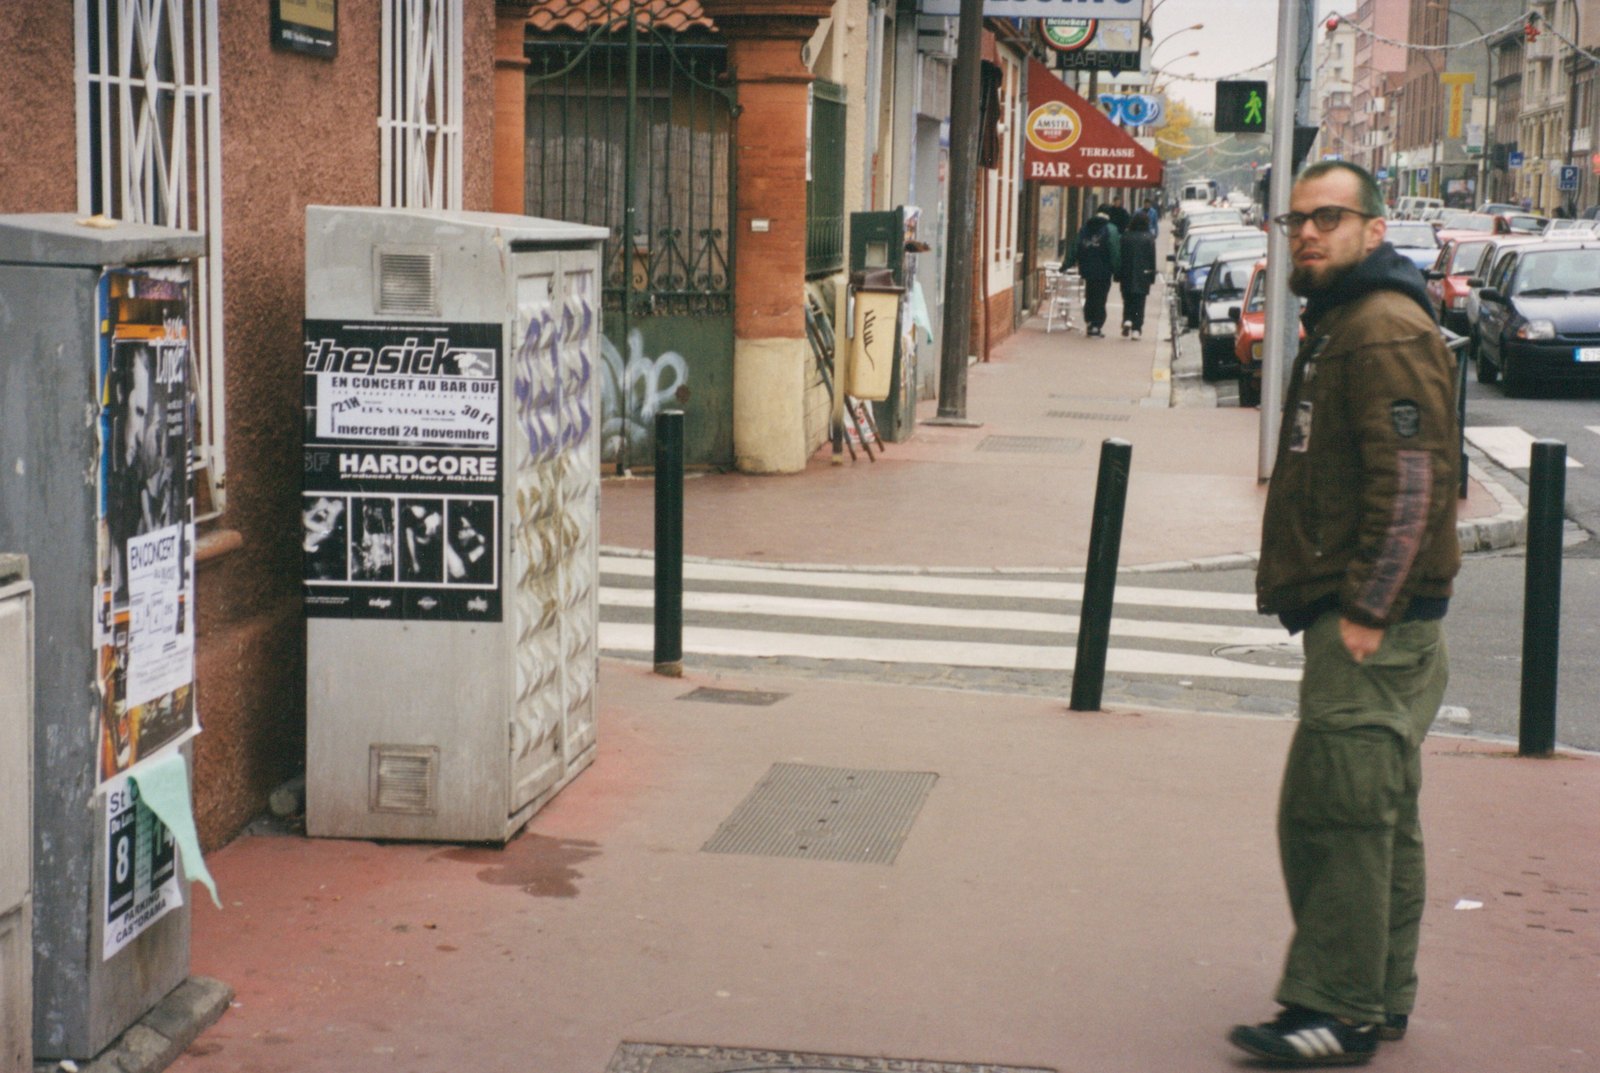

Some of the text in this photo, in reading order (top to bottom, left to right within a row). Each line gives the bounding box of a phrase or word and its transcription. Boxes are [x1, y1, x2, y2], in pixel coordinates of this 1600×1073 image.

[1037, 120, 1069, 128] AMSTEL
[1079, 147, 1135, 158] TERRASSE
[1031, 161, 1071, 177] BAR
[1087, 163, 1148, 180] GRILL
[1565, 168, 1574, 179] P
[331, 377, 497, 394] EN CONCERT AU BAR OUF
[335, 396, 361, 413] 21H
[460, 404, 480, 420] 30
[337, 424, 490, 440] mercredi 24 novembre
[339, 453, 497, 476] HARDCORE
[410, 474, 445, 482] Henry
[446, 475, 496, 483] ROLLINS
[131, 536, 176, 571] EN CONCERT
[110, 791, 125, 813] St
[115, 835, 129, 884] 8
[124, 891, 160, 925] PARKING
